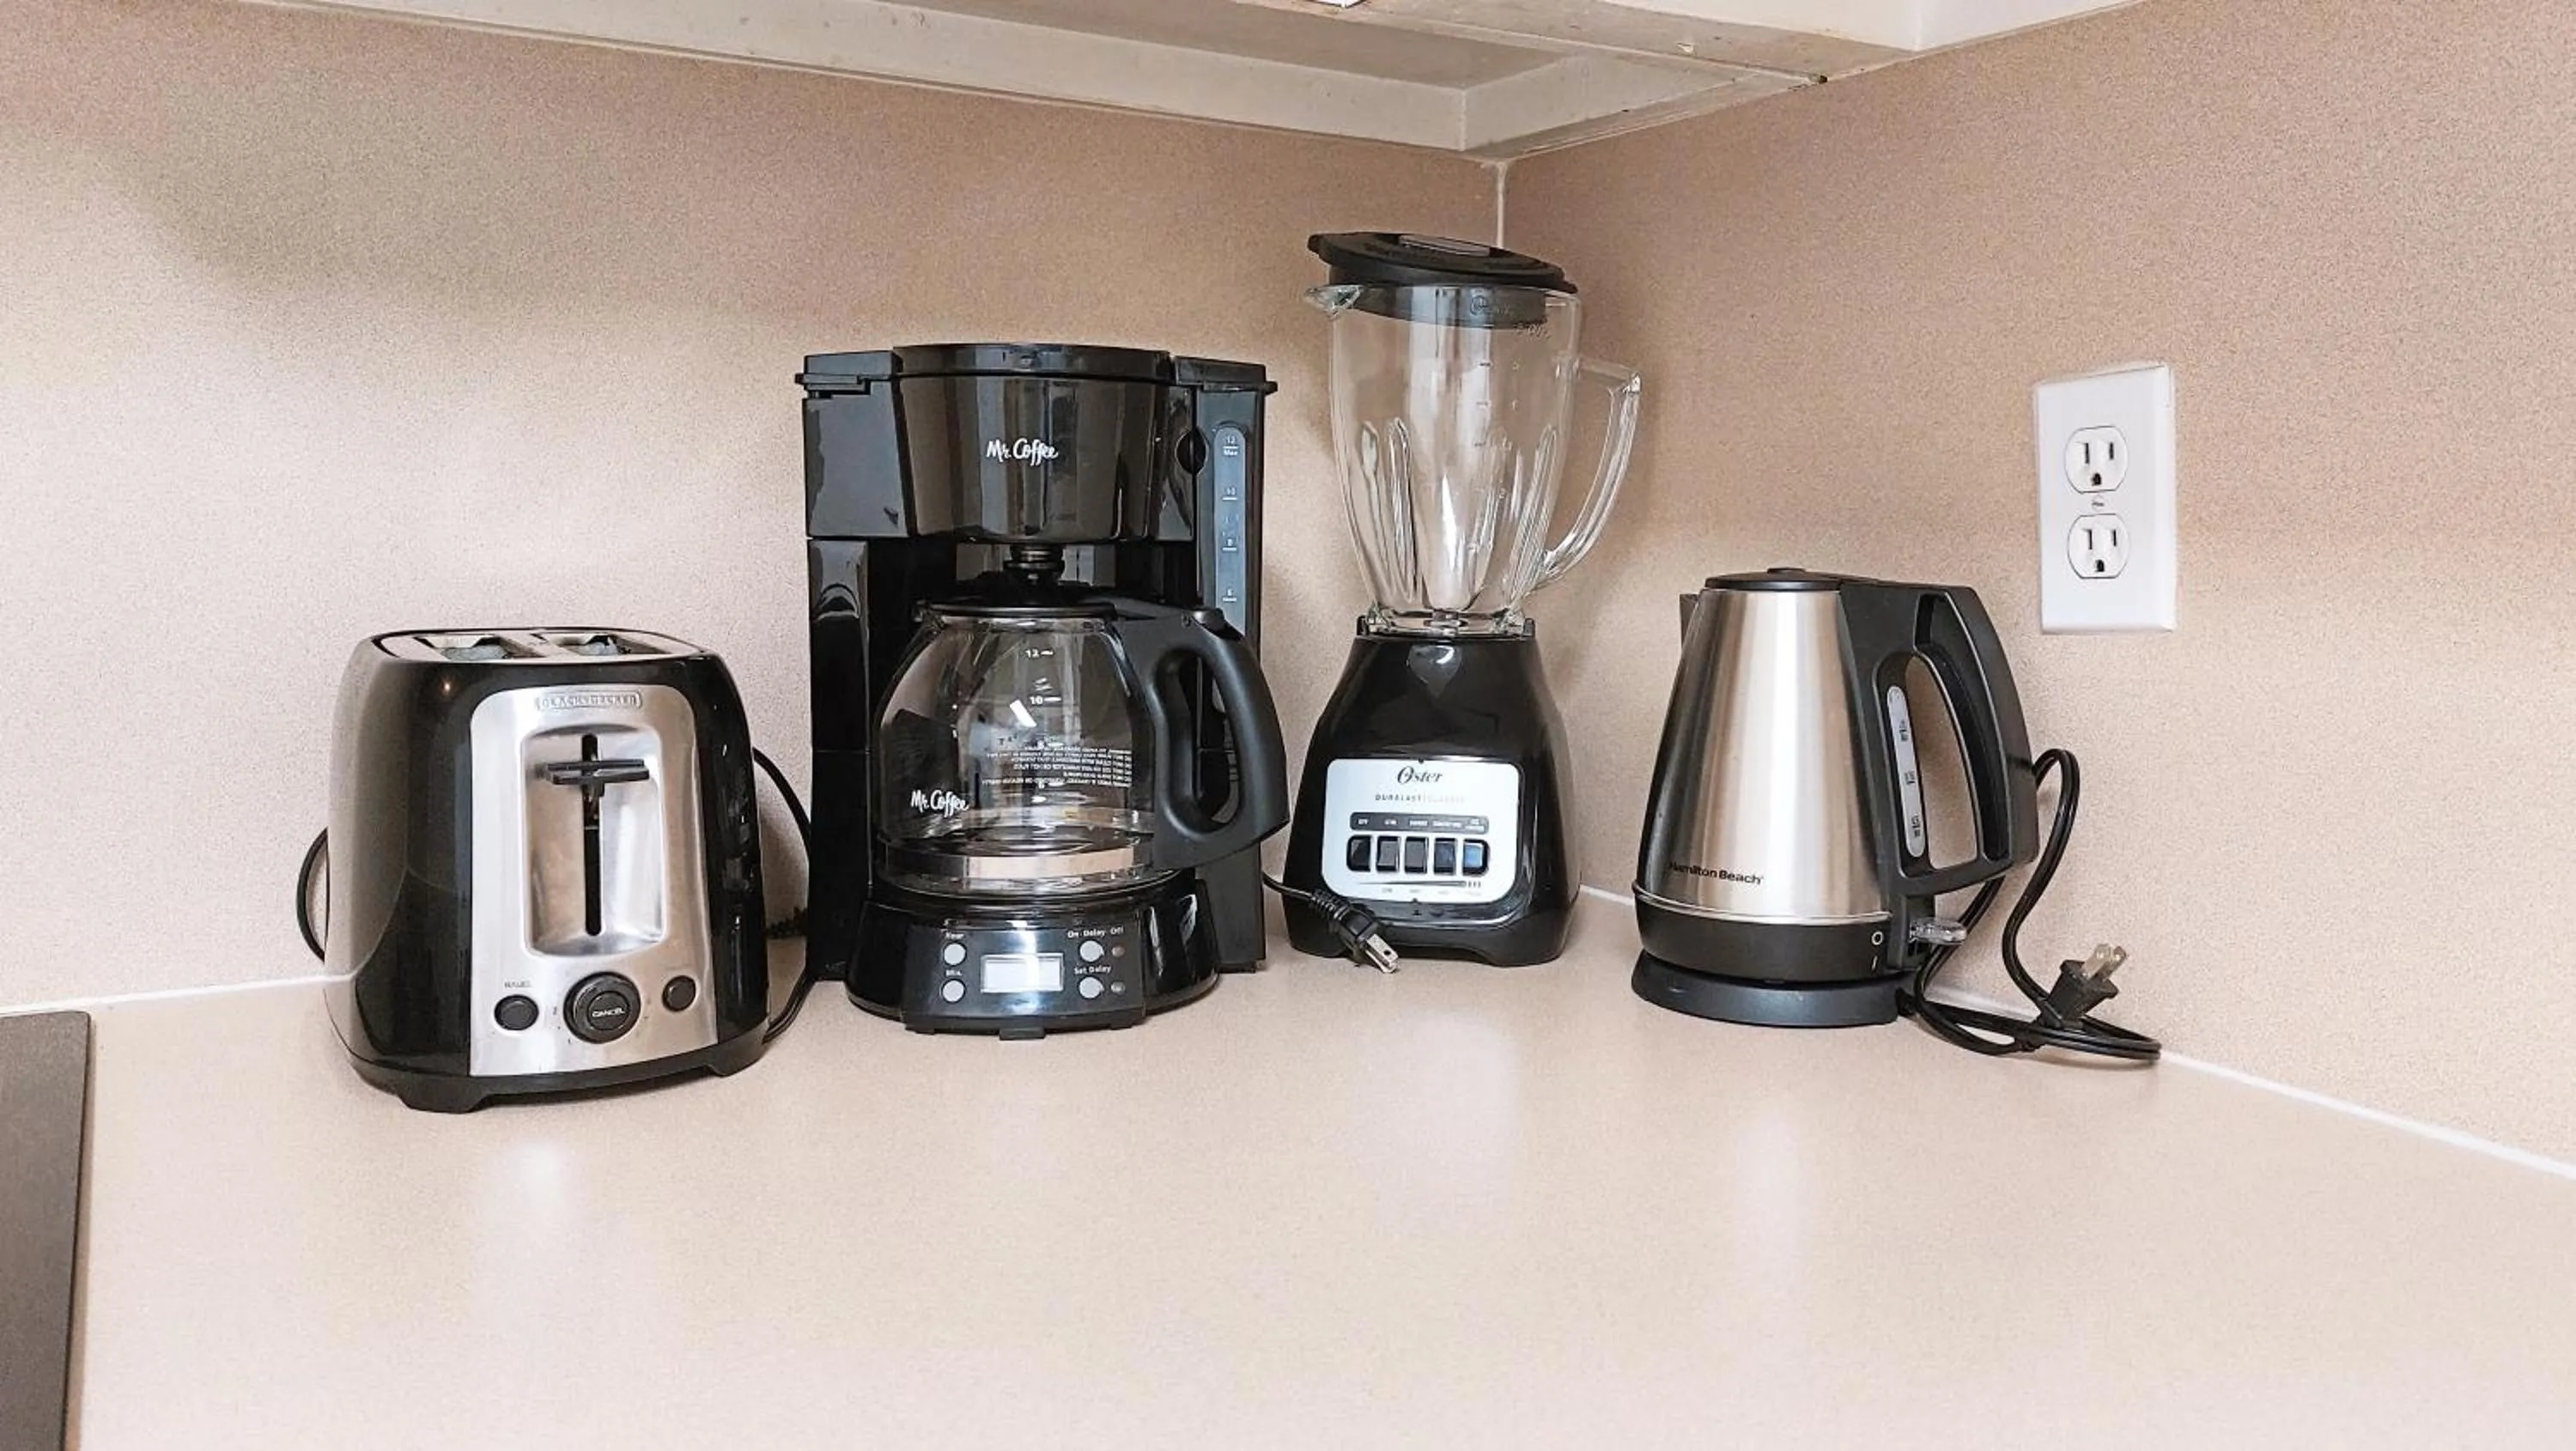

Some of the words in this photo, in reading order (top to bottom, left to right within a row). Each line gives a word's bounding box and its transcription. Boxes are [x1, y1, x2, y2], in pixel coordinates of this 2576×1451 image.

[986, 439, 1012, 463] Mr.
[1013, 437, 1059, 466] Coffee
[1030, 695, 1043, 705] 10
[1397, 765, 1443, 785] Oster
[911, 789, 929, 813] Mr.
[930, 789, 969, 817] Coffee
[1718, 870, 1761, 884] Beach
